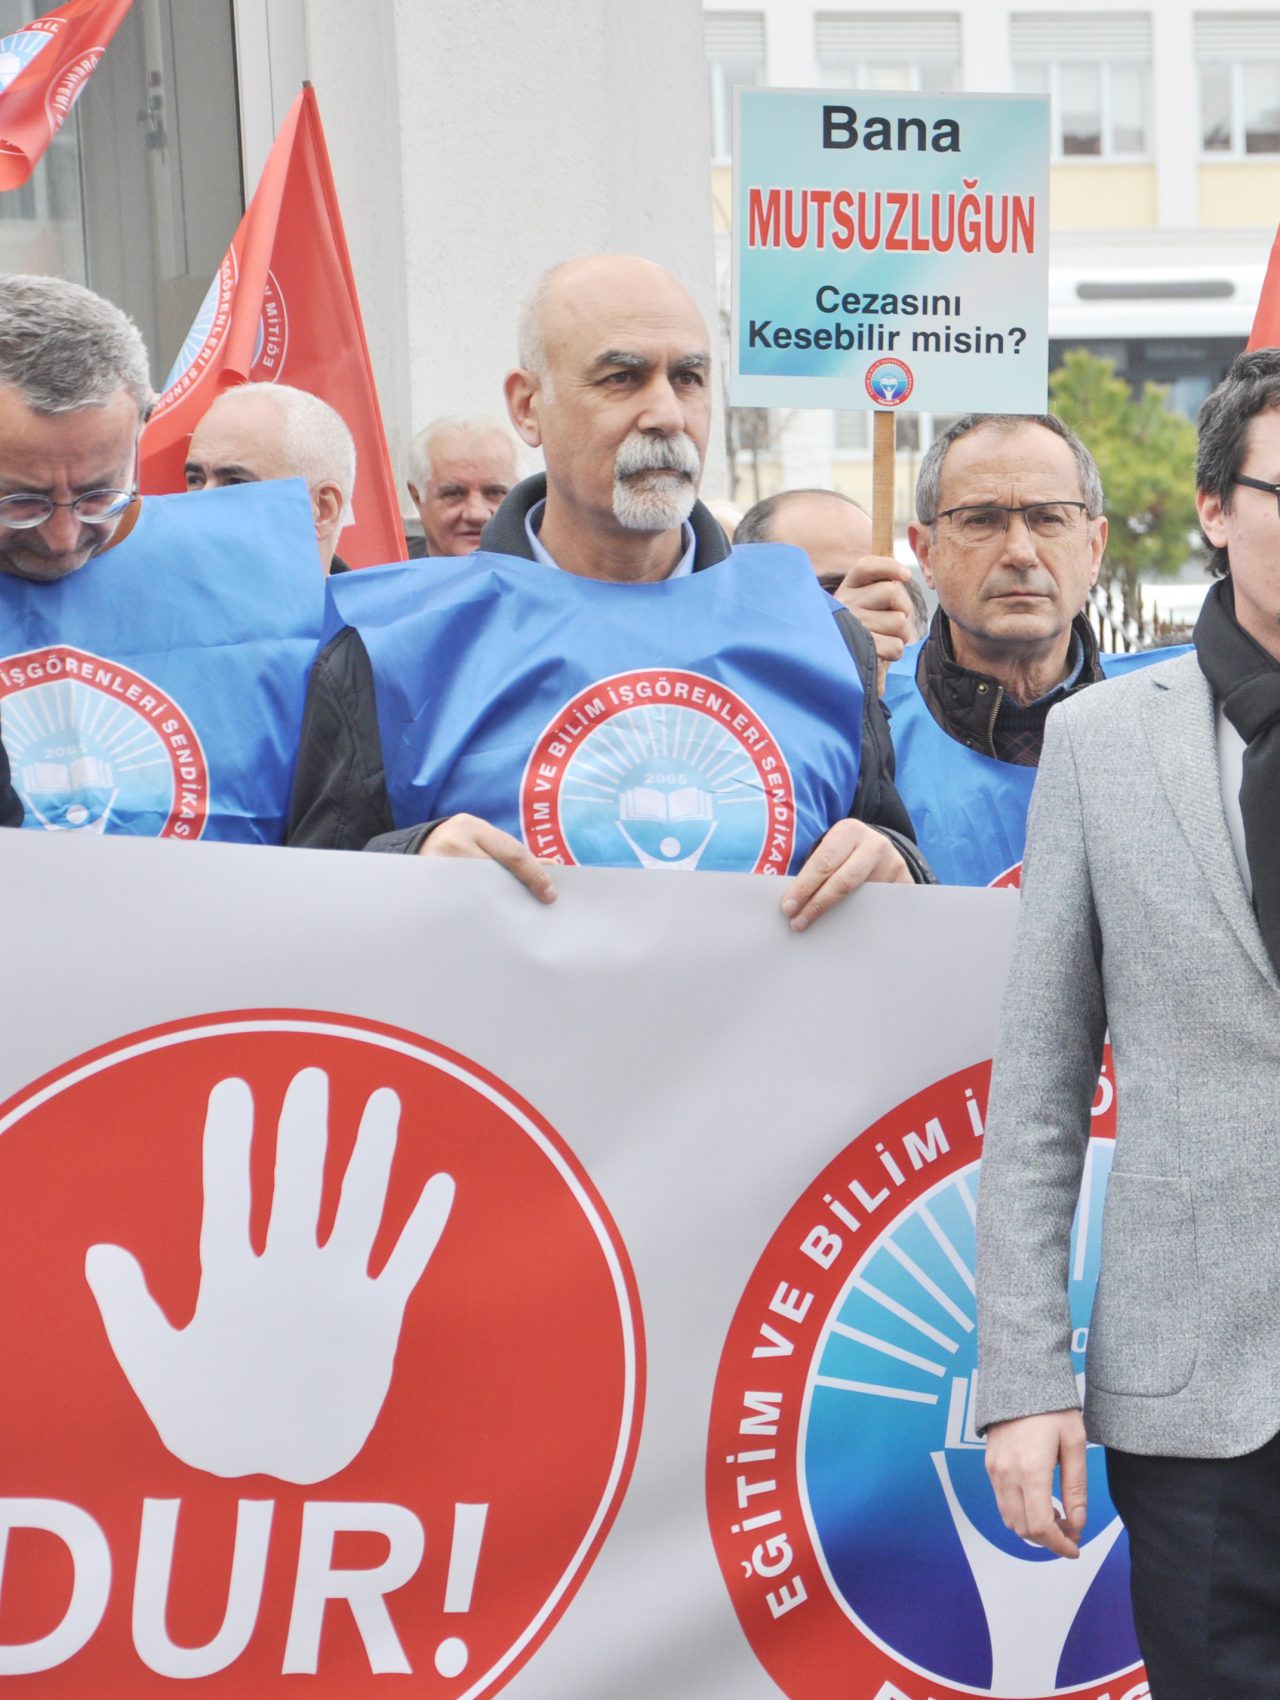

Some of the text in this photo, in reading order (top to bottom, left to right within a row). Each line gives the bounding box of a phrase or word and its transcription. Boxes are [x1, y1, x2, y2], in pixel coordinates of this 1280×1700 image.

[822, 105, 962, 153] Bana
[748, 178, 1036, 254] MUTSUZLUĞUN
[748, 320, 1028, 354] Kesebilir misin?
[815, 285, 961, 317] Cezasını
[162, 718, 203, 839] SENDİKAS
[533, 762, 557, 791] VE
[547, 697, 606, 758] BİLİM
[606, 676, 769, 752] İŞGÖRENLERİ
[761, 756, 790, 875] SENDİKAS
[643, 773, 688, 785] 2005
[726, 1117, 951, 1619] EĞİTİM VE BİLİM
[0, 1497, 490, 1679] DUR!
